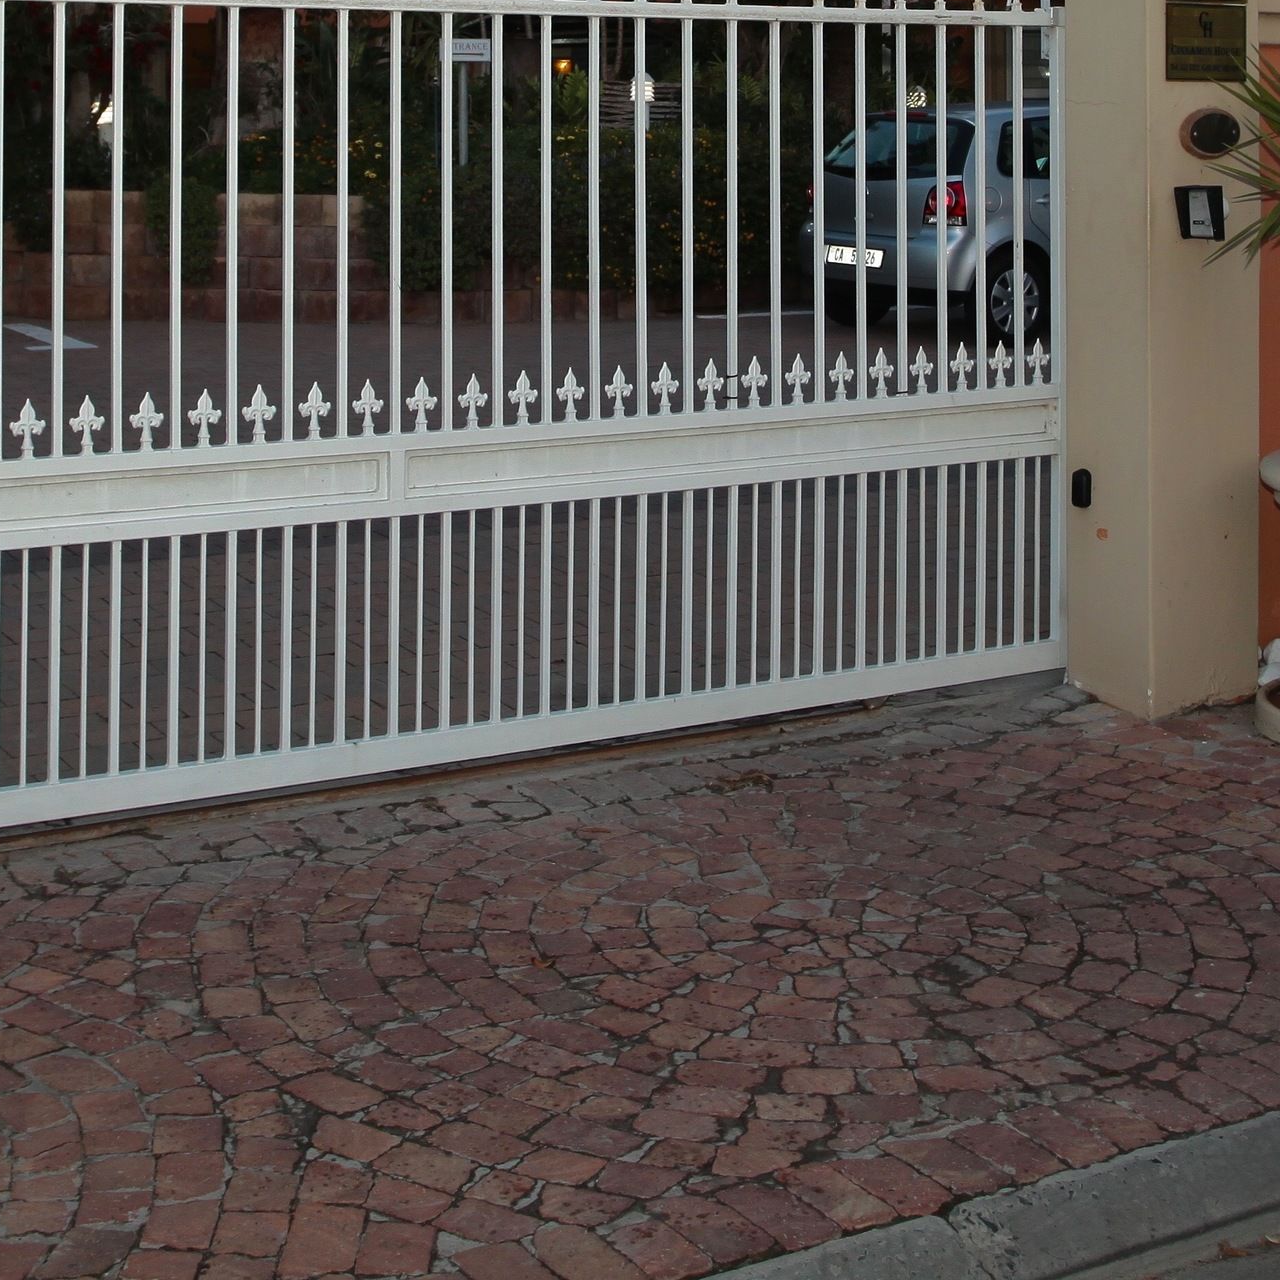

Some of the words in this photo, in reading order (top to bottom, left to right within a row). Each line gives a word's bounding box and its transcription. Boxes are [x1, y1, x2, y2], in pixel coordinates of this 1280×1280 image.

[452, 42, 488, 51] TRANCE
[835, 248, 843, 261] CA
[851, 249, 875, 264] 526
